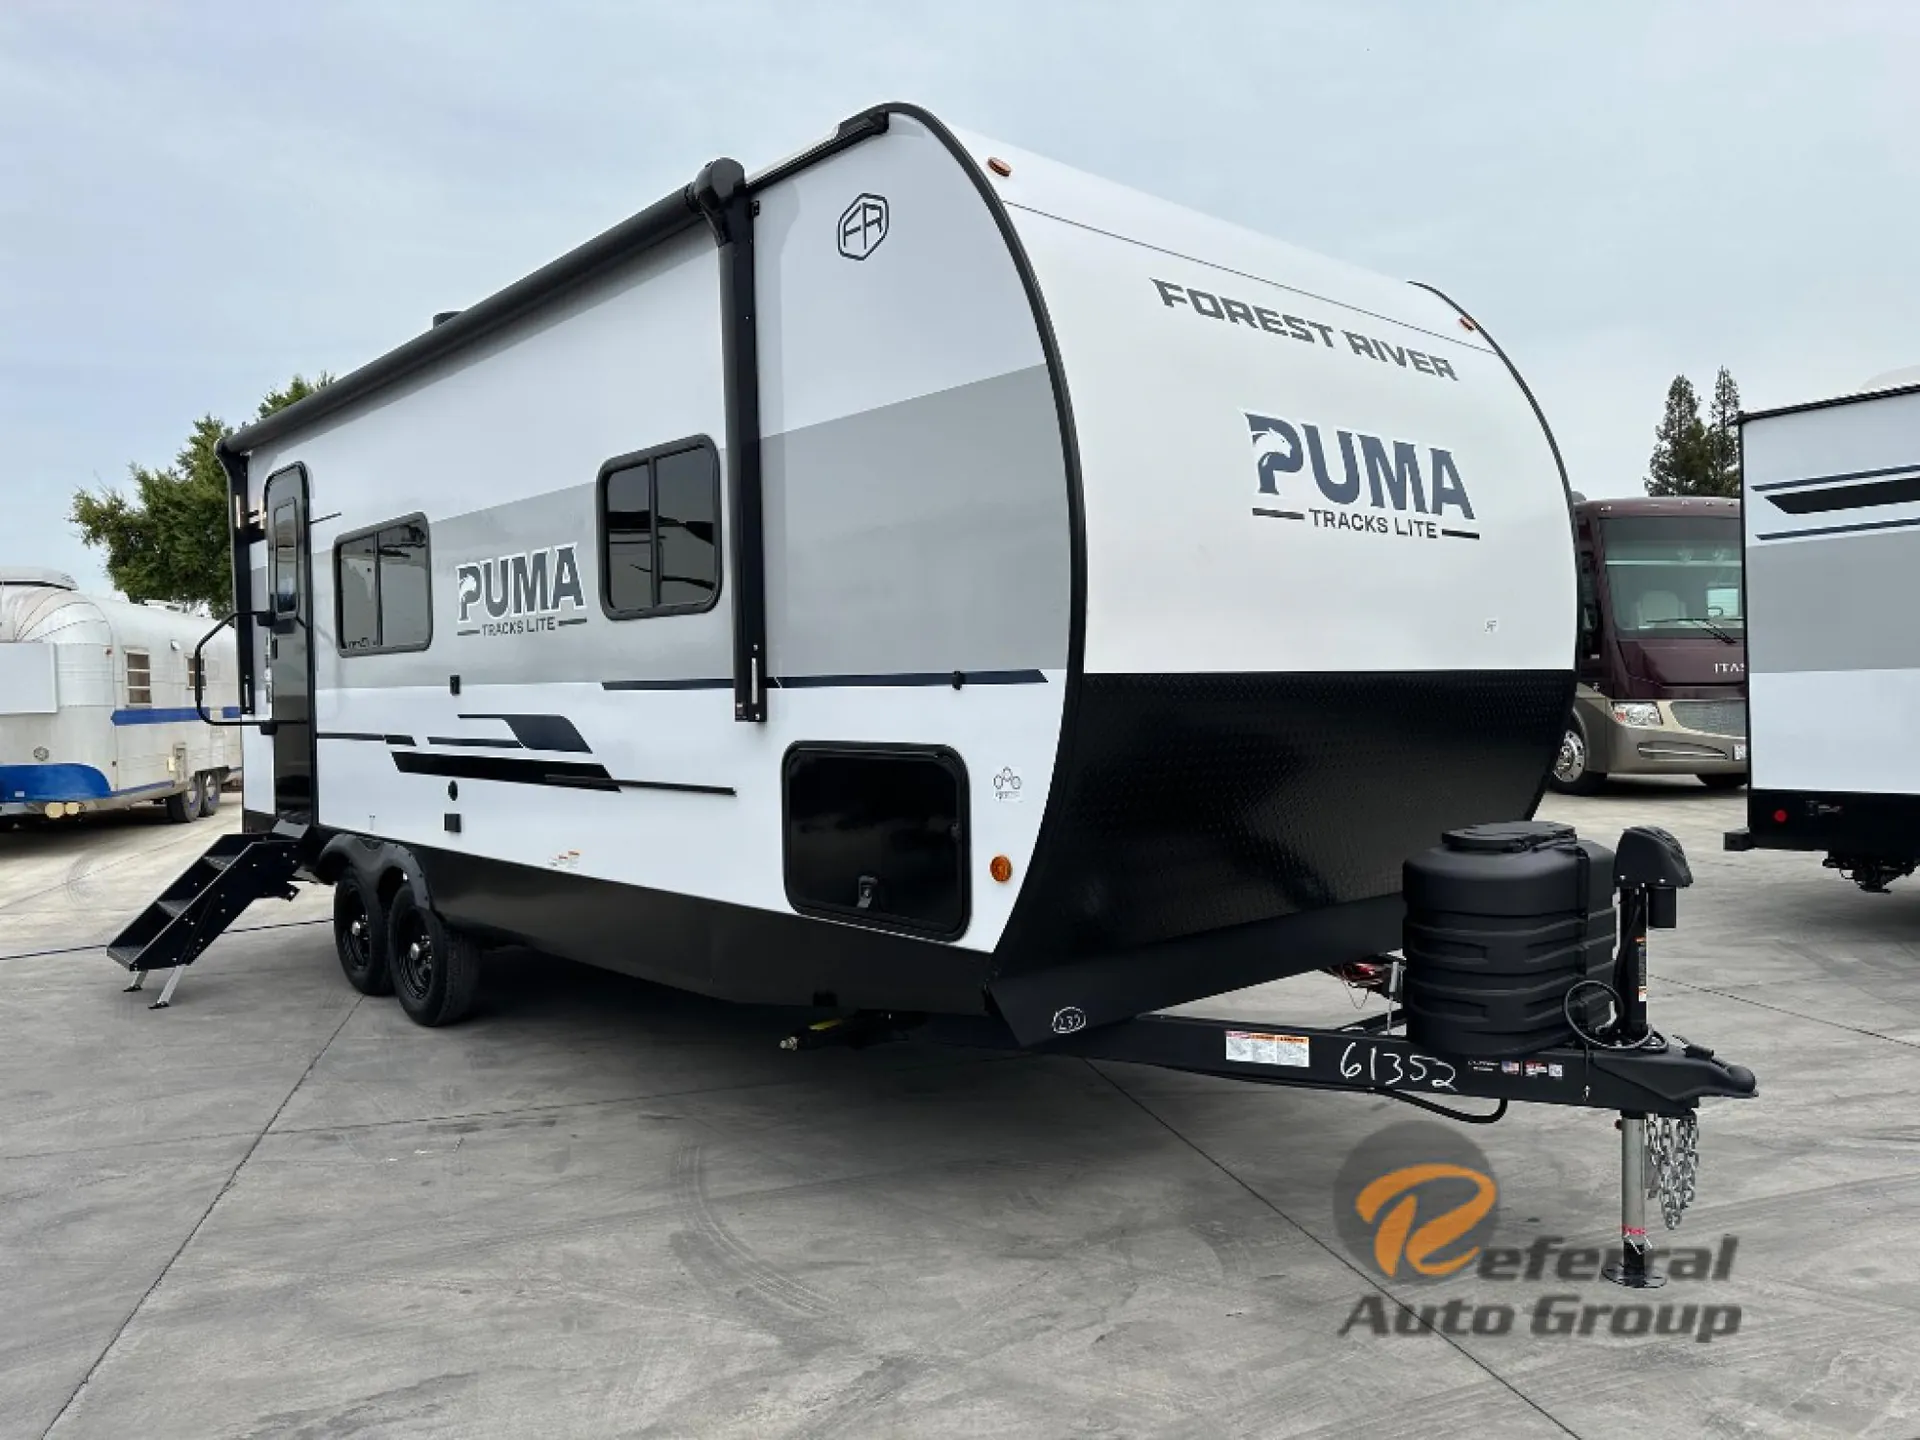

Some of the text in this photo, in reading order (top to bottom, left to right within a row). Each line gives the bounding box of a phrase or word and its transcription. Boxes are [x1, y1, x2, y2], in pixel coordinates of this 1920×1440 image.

[1150, 277, 1459, 381] FOREST RIVER
[1242, 411, 1476, 521] PUMA
[1308, 508, 1438, 539] TRACKS LITE
[456, 543, 586, 623] PUMA
[481, 616, 556, 636] TRACKS LITE
[1340, 1041, 1458, 1092] 61352
